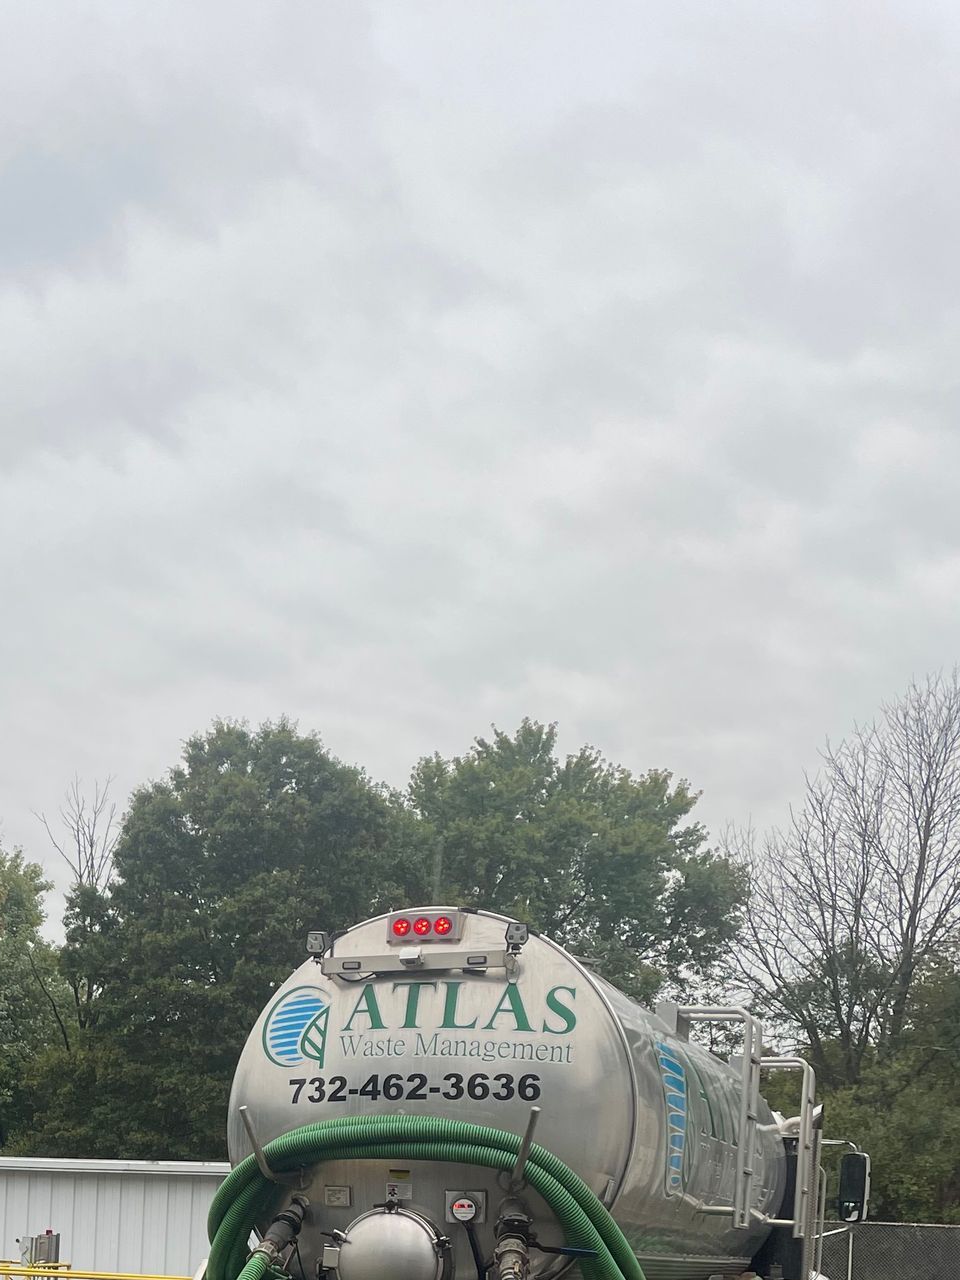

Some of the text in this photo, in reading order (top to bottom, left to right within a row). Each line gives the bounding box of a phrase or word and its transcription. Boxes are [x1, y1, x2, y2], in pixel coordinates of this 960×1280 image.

[340, 981, 577, 1035] ATLAS
[339, 1032, 576, 1065] Waste Management
[289, 1073, 541, 1104] 732-462-3636
